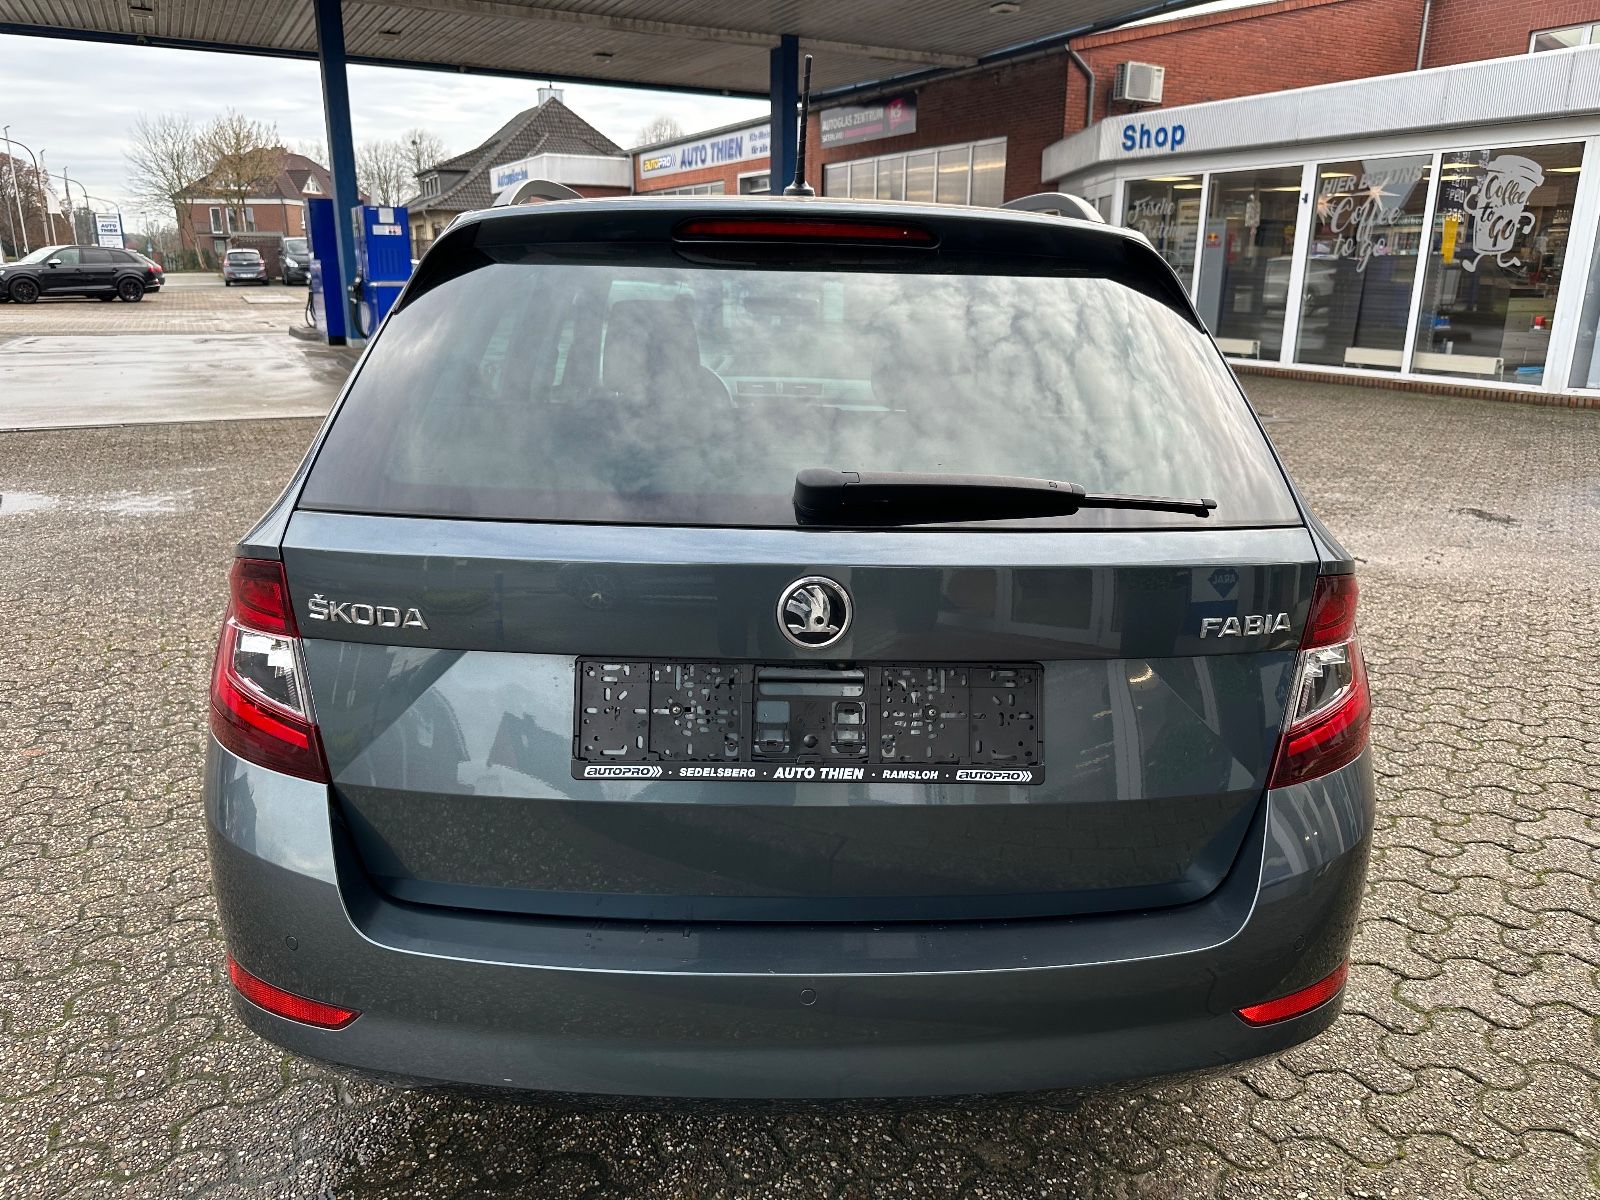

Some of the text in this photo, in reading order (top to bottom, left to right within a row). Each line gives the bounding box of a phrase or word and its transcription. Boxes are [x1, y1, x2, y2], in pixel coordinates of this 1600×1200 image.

[1122, 124, 1185, 151] Shop
[680, 144, 707, 169] AUTO
[710, 136, 743, 163] THIEN
[1322, 175, 1357, 194] HIER
[1485, 174, 1526, 206] Coffee
[1128, 195, 1176, 224] Frische
[1331, 197, 1401, 242] Coffee
[1478, 201, 1496, 222] to
[1333, 234, 1386, 272] to go
[308, 593, 429, 630] ŠKODA
[1200, 612, 1291, 639] FABIA
[679, 767, 756, 777] SEDELSBERG
[773, 766, 815, 779] AUTO
[820, 767, 864, 780] THIEN
[882, 769, 939, 780] RAMSLOH
